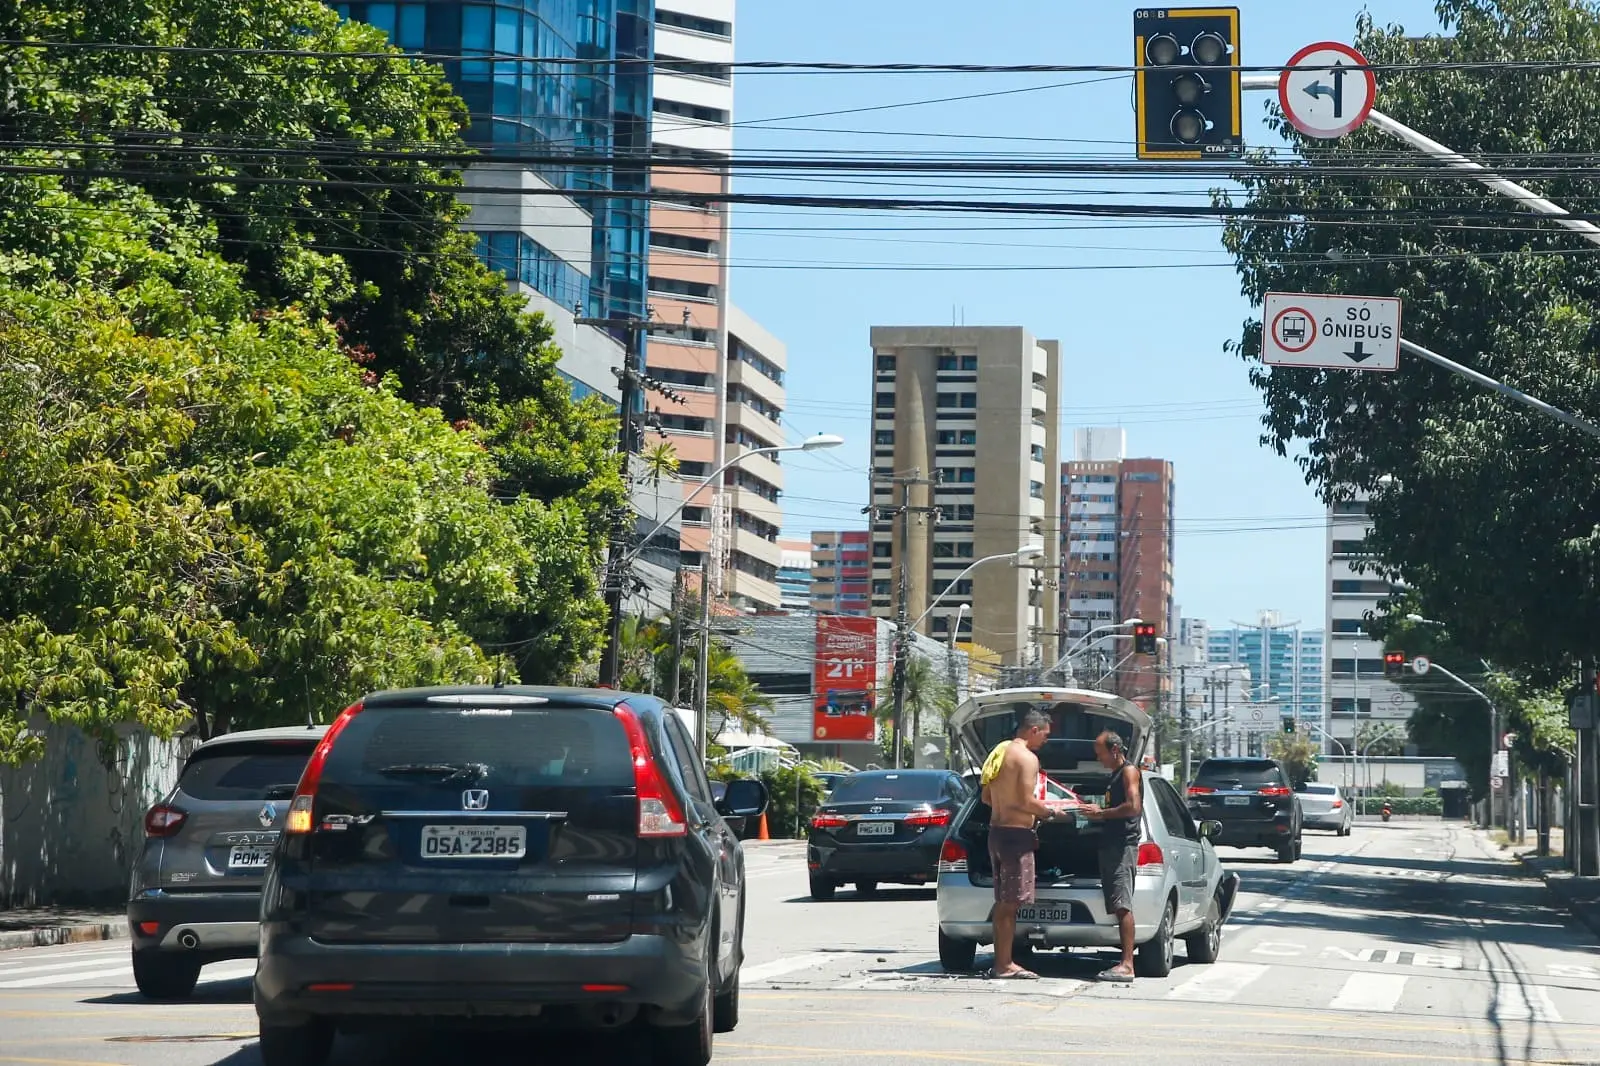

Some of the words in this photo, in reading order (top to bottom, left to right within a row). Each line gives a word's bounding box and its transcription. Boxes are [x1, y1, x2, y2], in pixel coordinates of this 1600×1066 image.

[1136, 10, 1149, 18] 06
[1346, 302, 1371, 321] SÓ
[1322, 317, 1392, 339] ÔNIBUS
